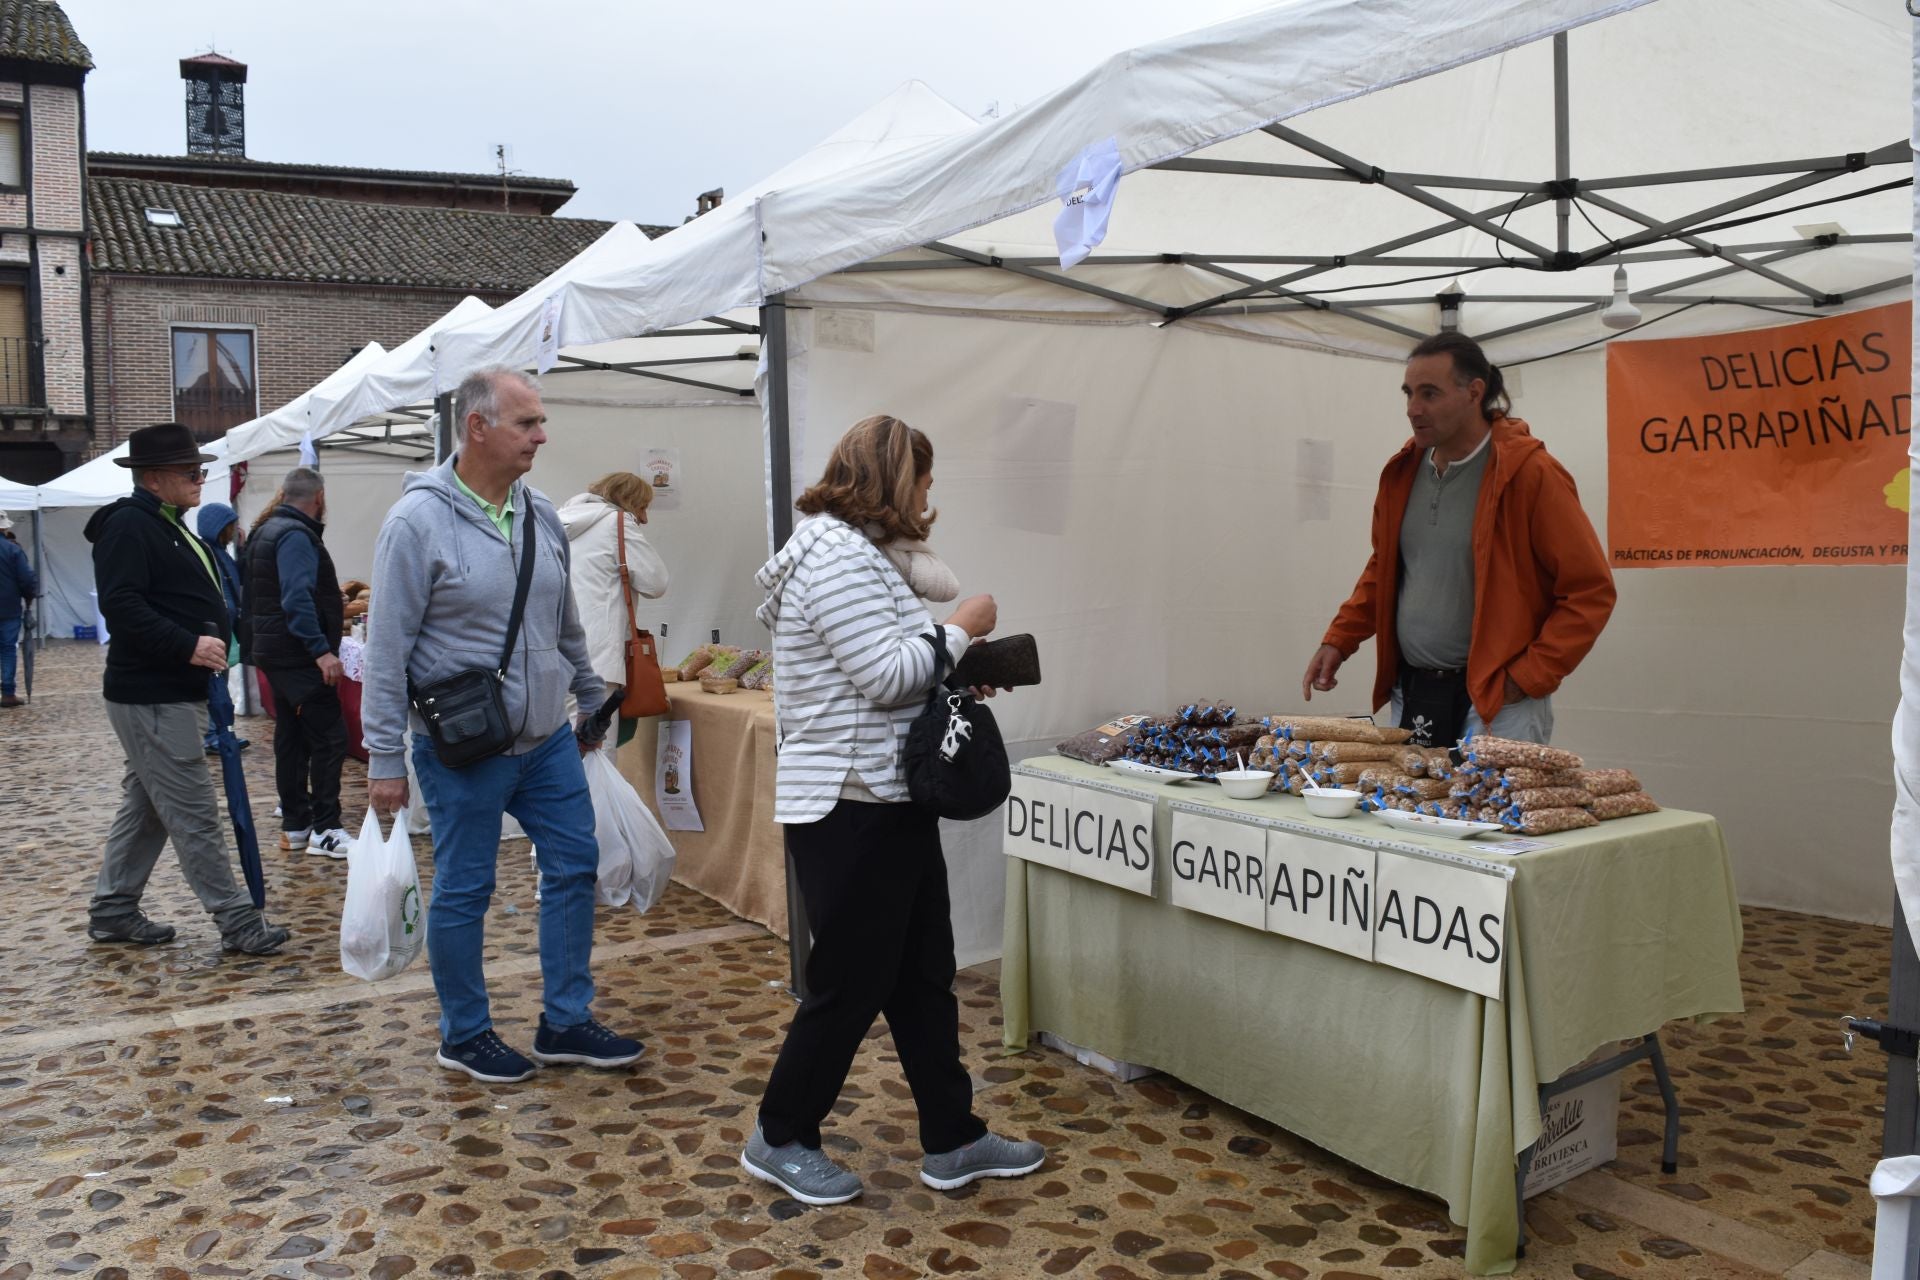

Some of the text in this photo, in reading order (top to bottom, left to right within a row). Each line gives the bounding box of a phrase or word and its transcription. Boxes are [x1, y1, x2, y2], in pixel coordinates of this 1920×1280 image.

[1701, 332, 1890, 391] DELICIAS
[1614, 547, 1673, 561] PRÁCTICAS
[1677, 549, 1692, 560] DE
[1695, 545, 1805, 560] PRONUNCIACIÓN,
[1812, 546, 1875, 558] DEGUSTA
[1879, 545, 1888, 557] Y
[1007, 795, 1501, 965] DELICIAS GARRAPIÑADAS
[1534, 1138, 1589, 1172] BRIVIESCA
